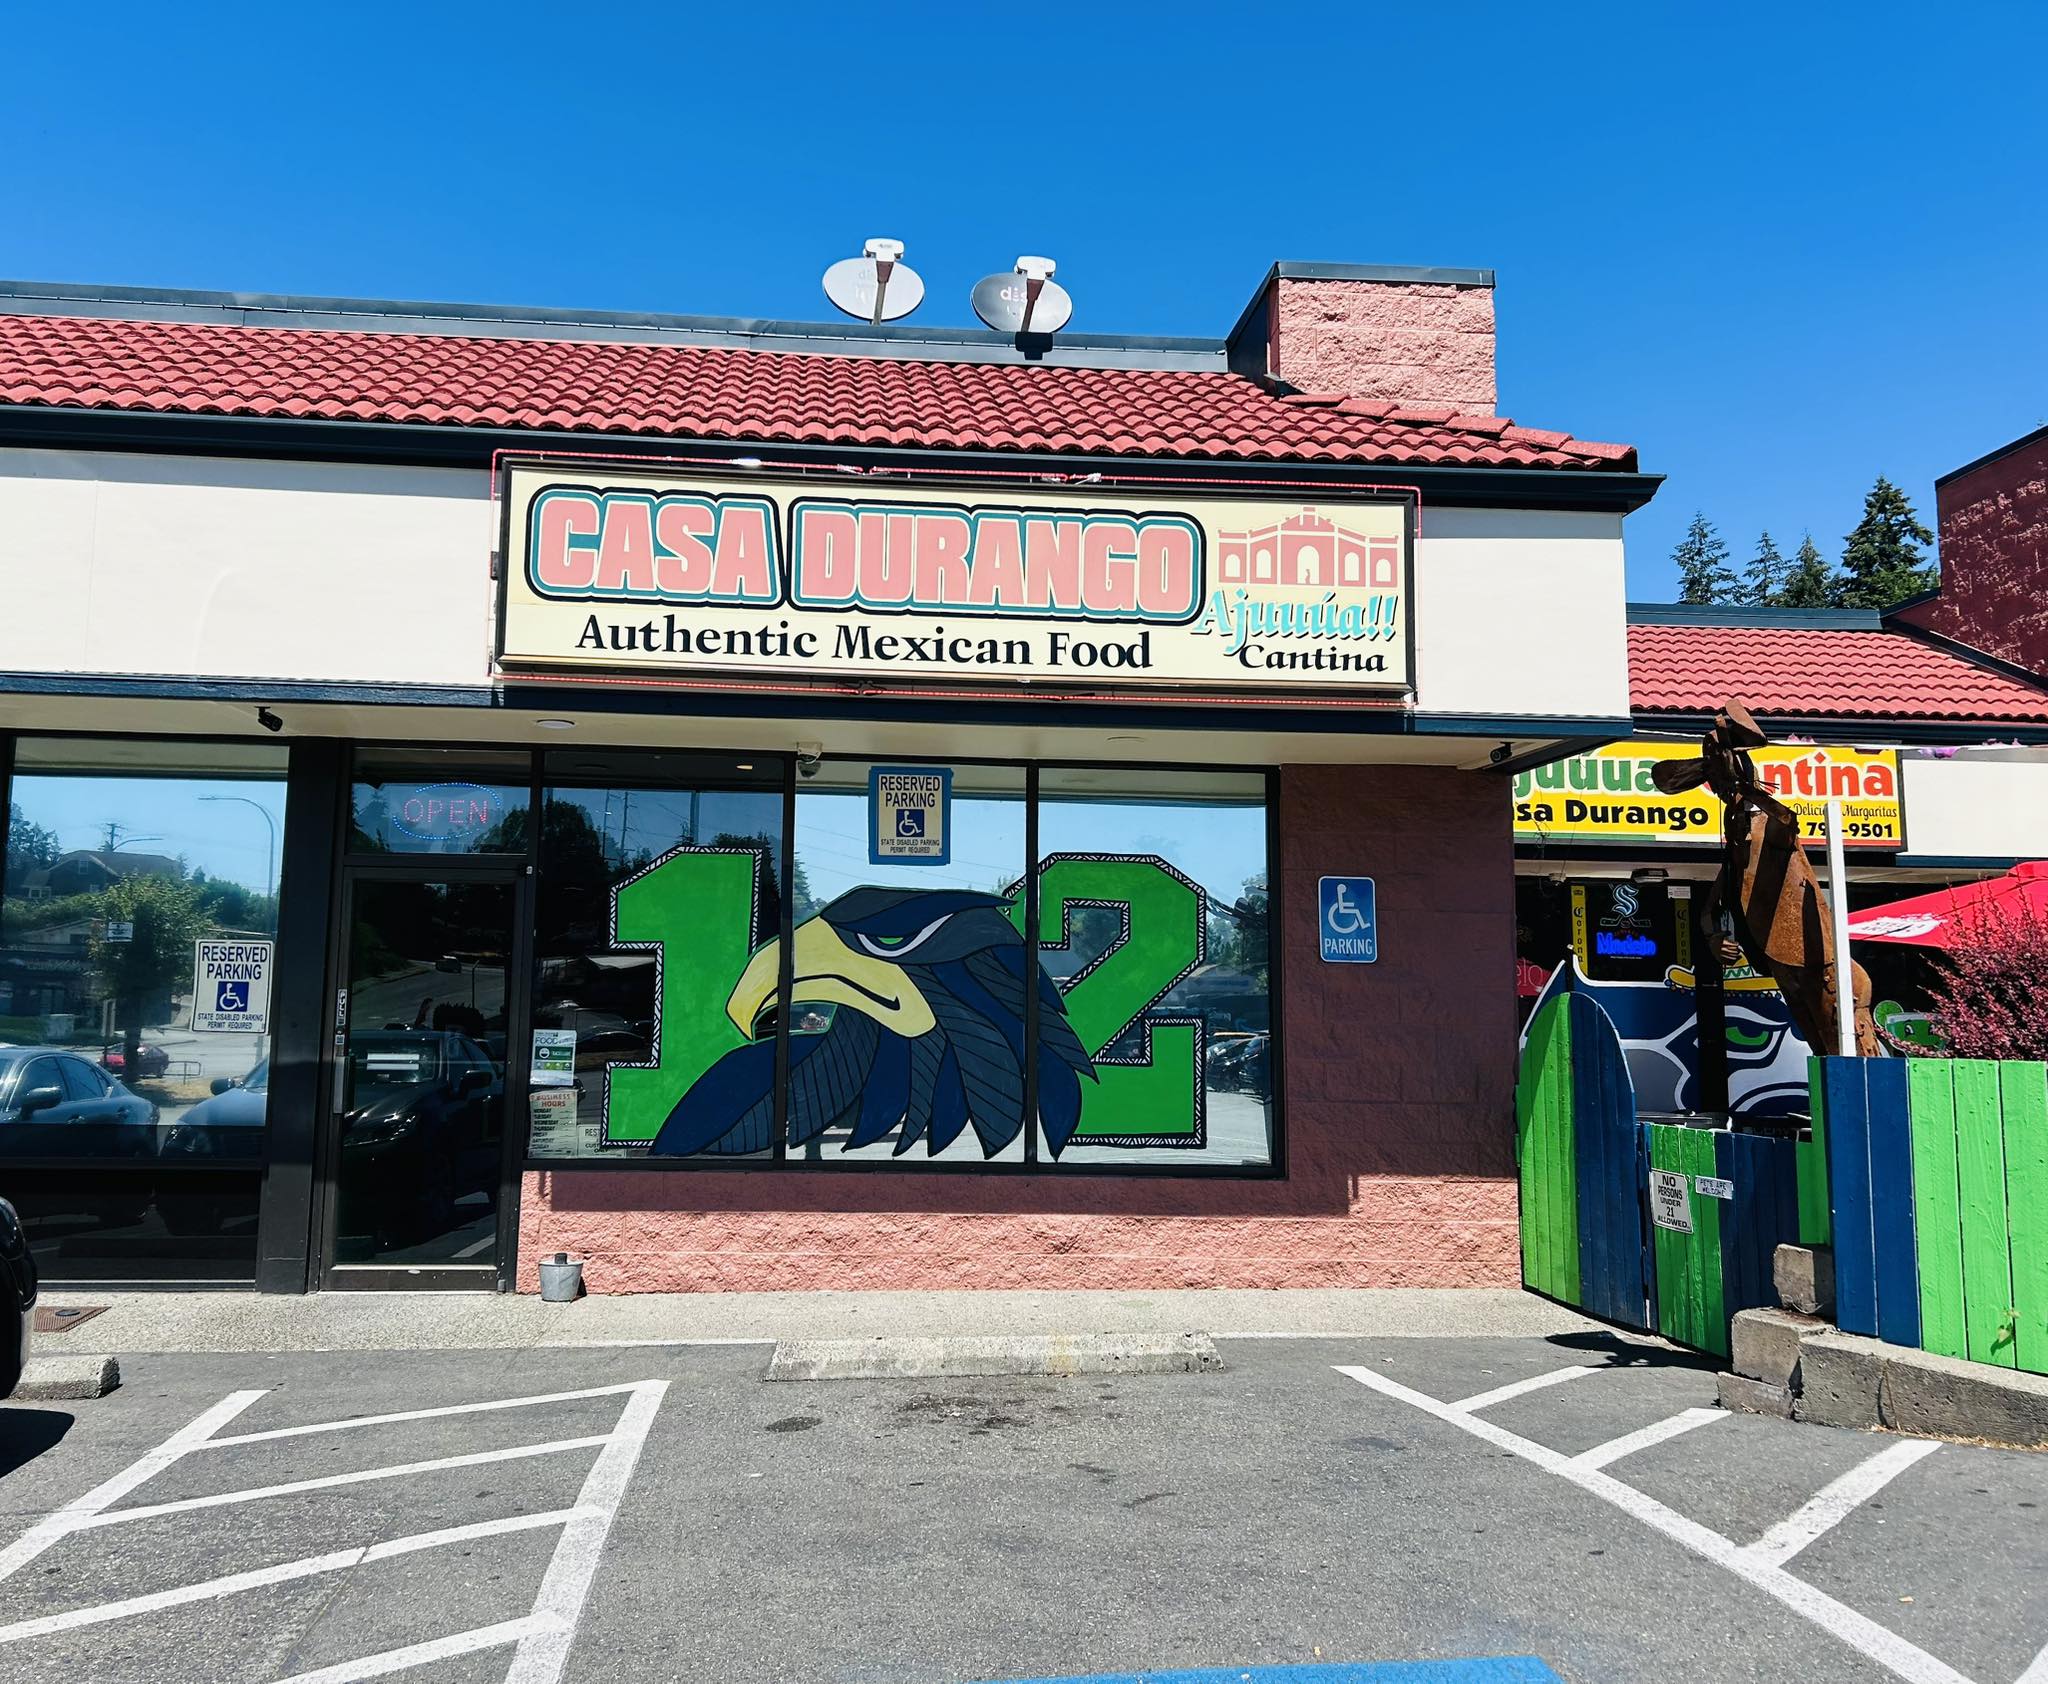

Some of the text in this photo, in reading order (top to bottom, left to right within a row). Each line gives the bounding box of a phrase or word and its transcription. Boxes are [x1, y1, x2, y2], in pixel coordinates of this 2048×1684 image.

[536, 496, 1195, 615] CASA DURANGO
[575, 614, 1153, 668] Authentic Mexican Food
[1239, 645, 1388, 672] Cantina
[880, 776, 940, 792] RESERVED
[885, 792, 936, 807] PARKING
[404, 798, 488, 824] OPEN
[1565, 799, 1709, 831] Durango
[1842, 805, 1897, 821] Margaritas
[1806, 822, 1893, 838] 79-9501
[920, 839, 940, 847] PARKING
[1573, 906, 1585, 963] Corona
[201, 945, 268, 962] RESERVED
[1324, 938, 1373, 955] PARKING
[207, 963, 262, 980] PARKING
[198, 1012, 263, 1022] STATE DISABLED PARKING
[228, 1021, 253, 1029] REQUIRED
[1662, 1175, 1676, 1187] NO
[1658, 1185, 1683, 1200] PERSONS
[1660, 1198, 1682, 1208] UNDER
[1666, 1206, 1675, 1217] 21
[1657, 1215, 1688, 1228] ALLOWED
